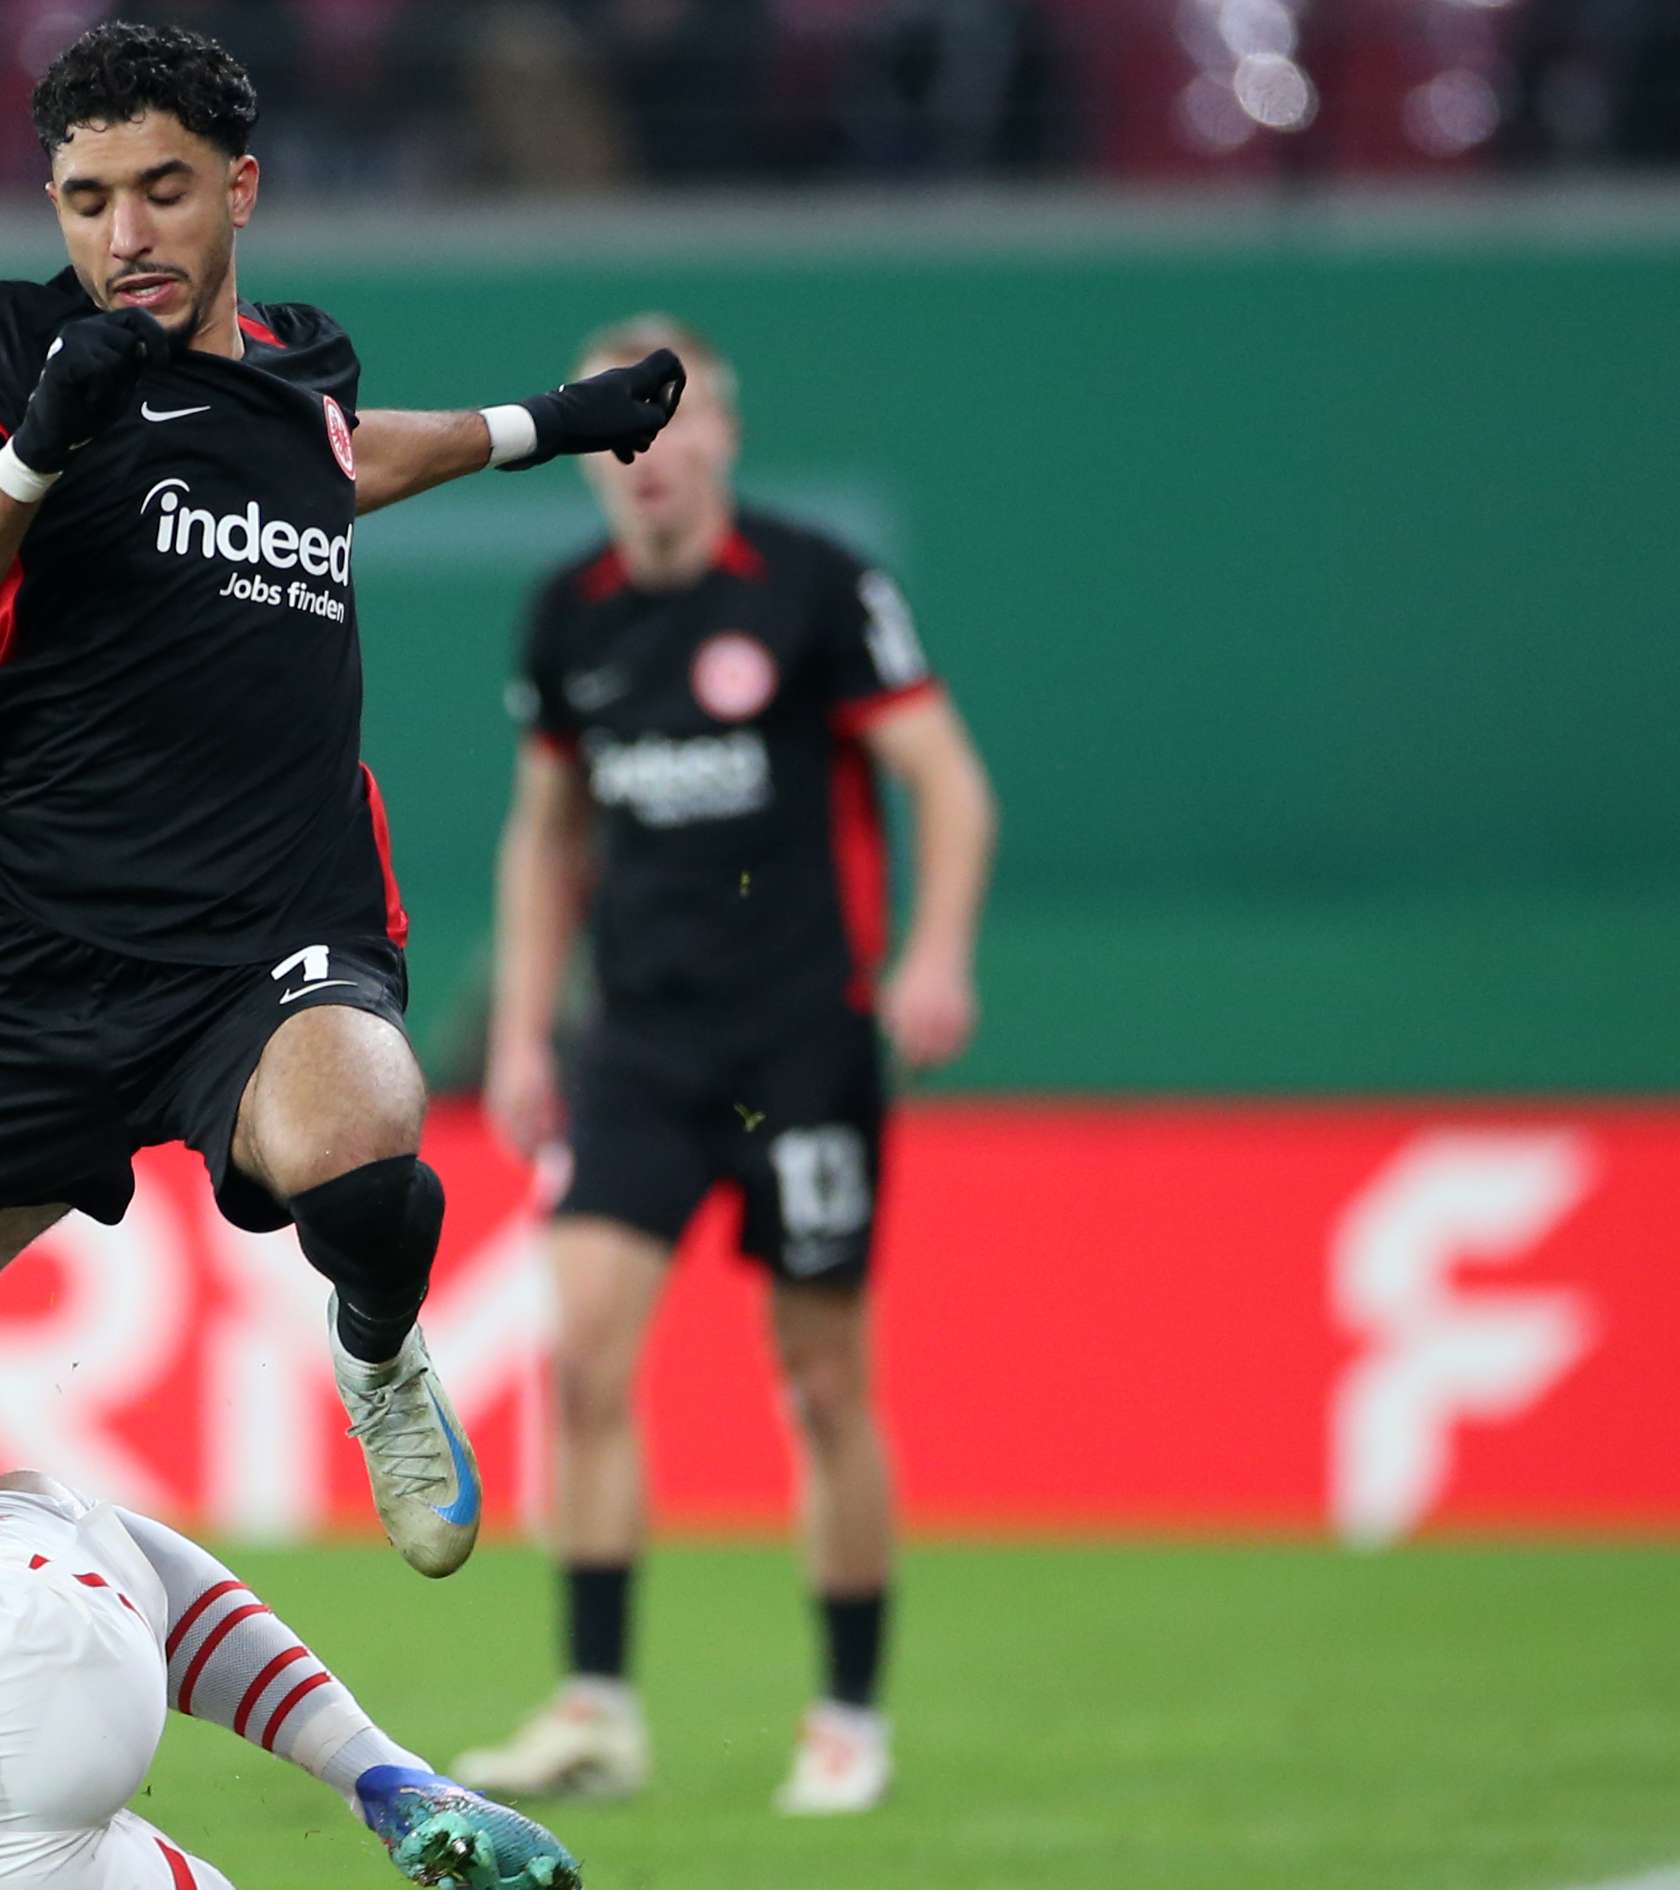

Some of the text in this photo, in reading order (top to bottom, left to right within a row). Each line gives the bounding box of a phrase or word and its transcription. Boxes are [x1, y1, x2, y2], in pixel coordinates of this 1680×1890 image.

[142, 479, 353, 587] indeed
[220, 572, 345, 624] Jobs finden
